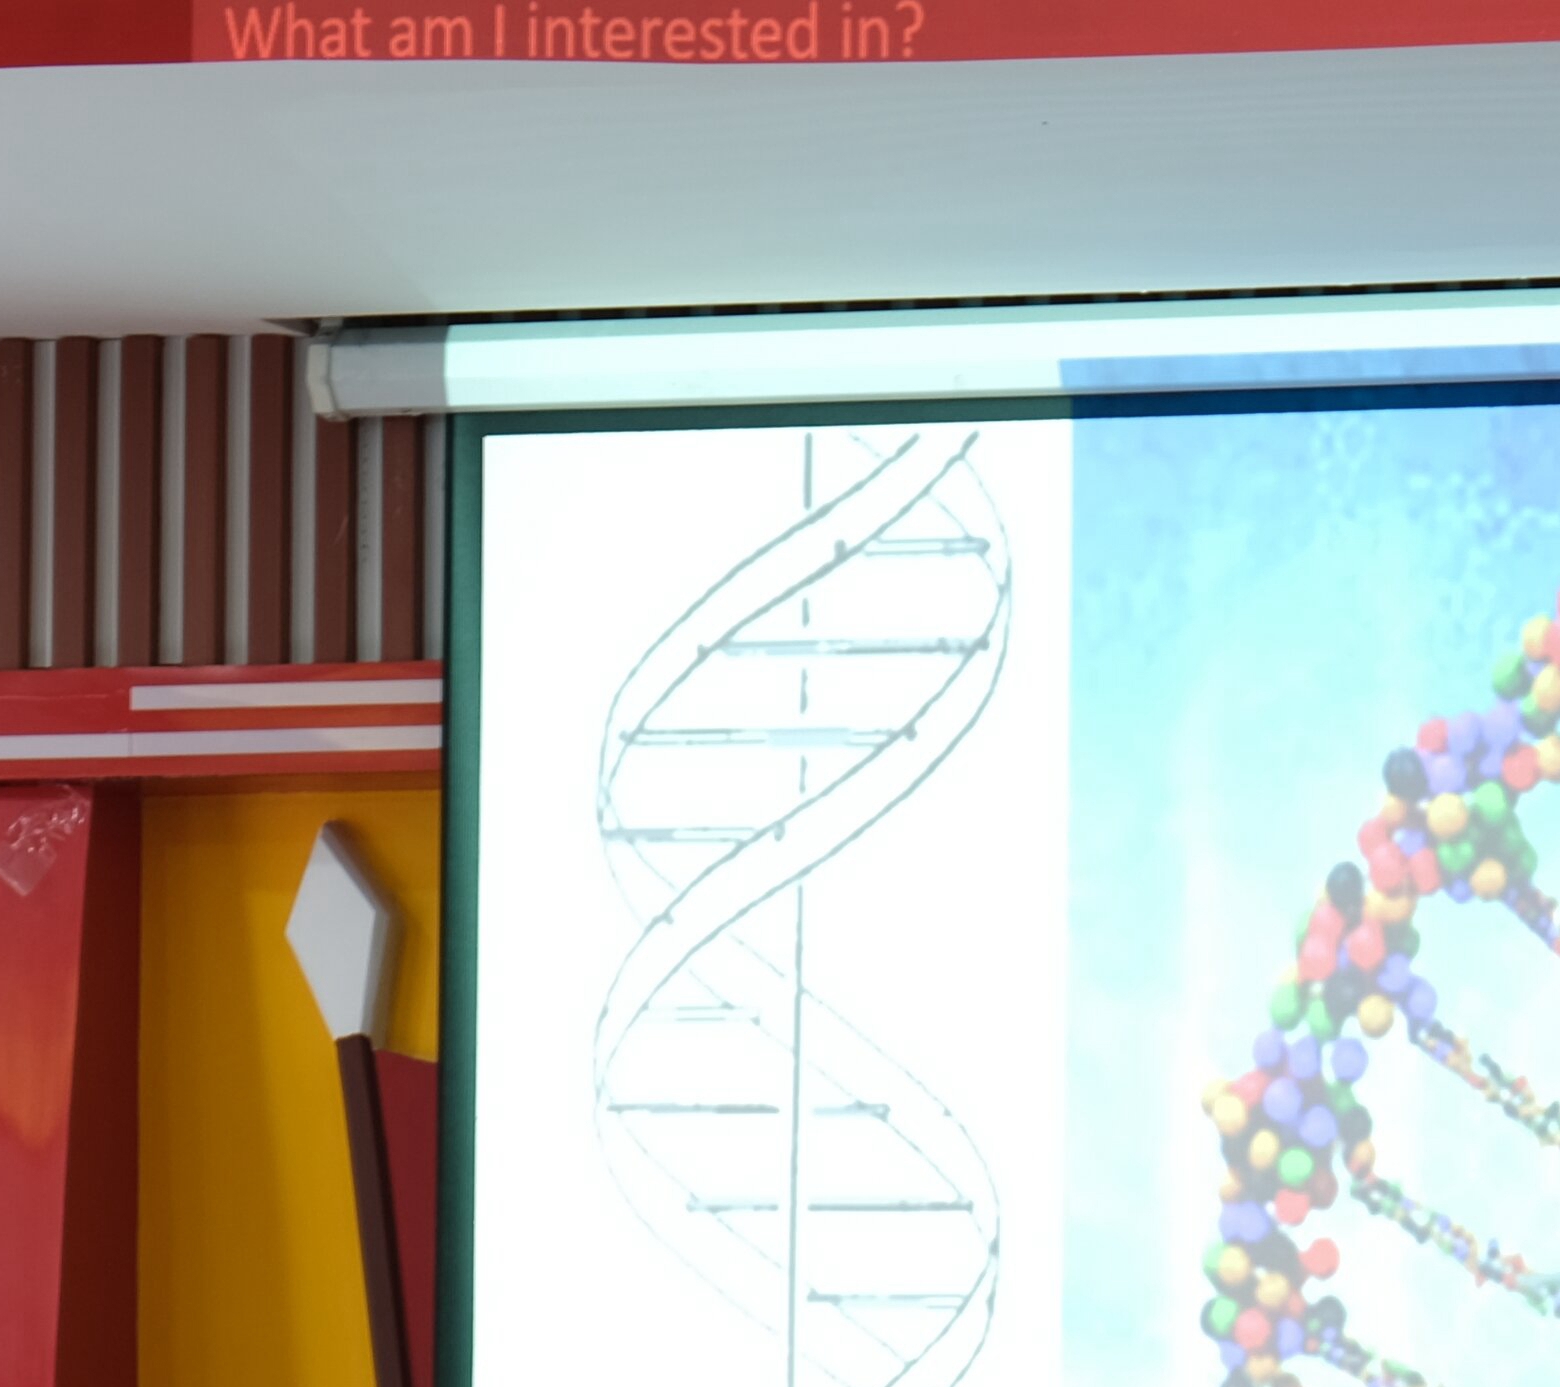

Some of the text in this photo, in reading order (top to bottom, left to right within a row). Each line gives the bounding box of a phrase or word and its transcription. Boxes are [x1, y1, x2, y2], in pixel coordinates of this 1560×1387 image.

[224, 0, 925, 60] What am I interested in?
